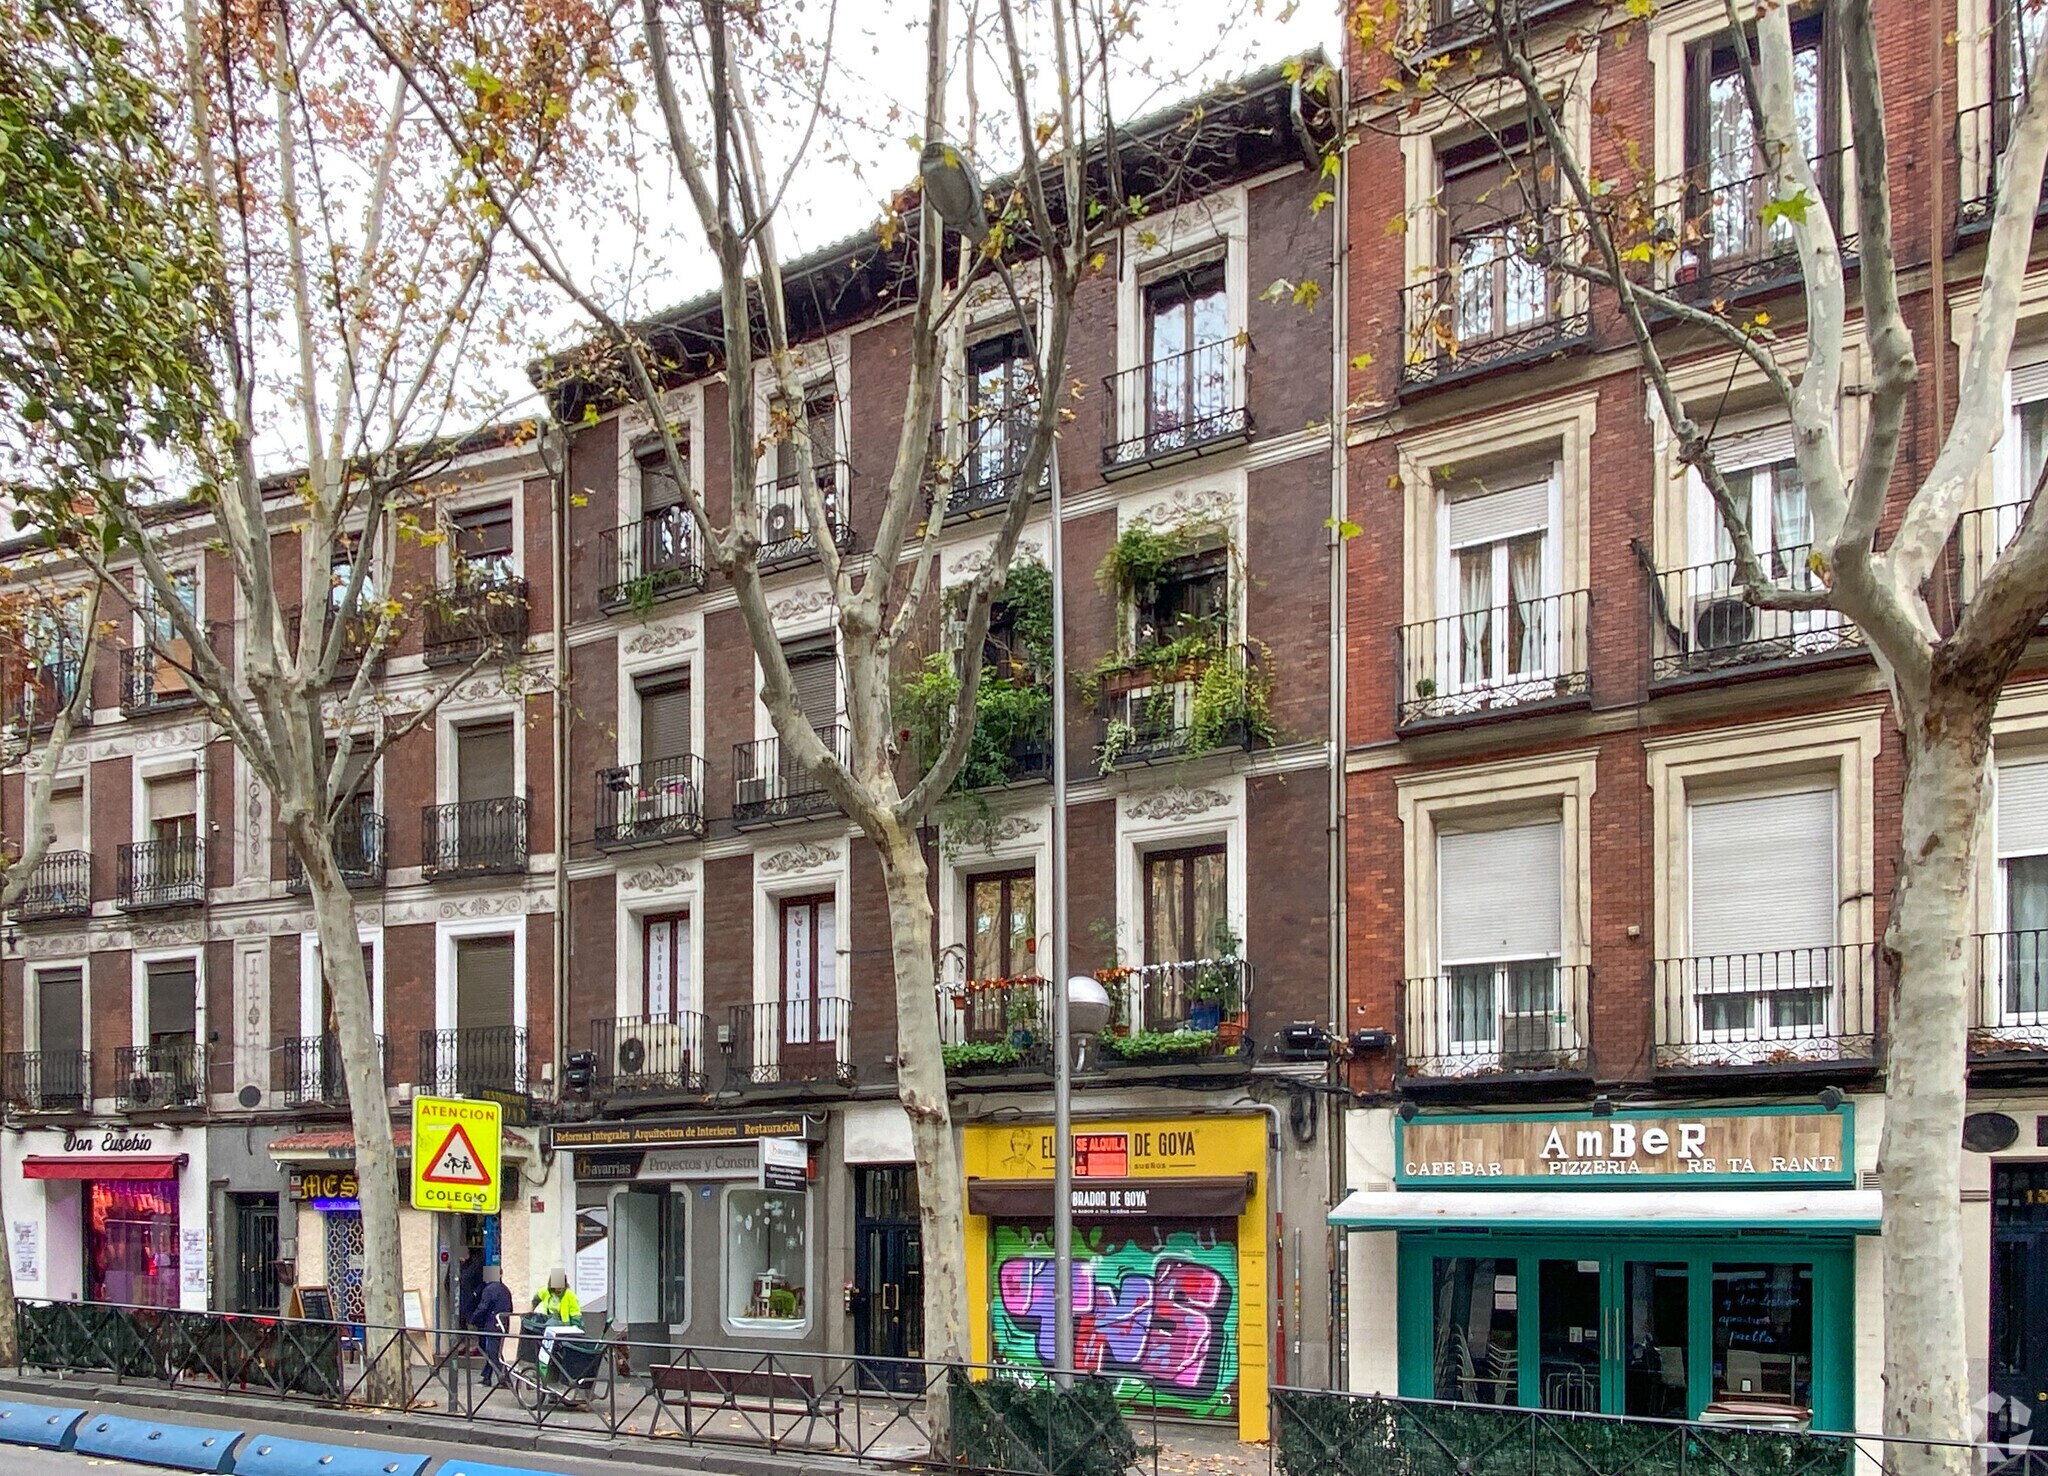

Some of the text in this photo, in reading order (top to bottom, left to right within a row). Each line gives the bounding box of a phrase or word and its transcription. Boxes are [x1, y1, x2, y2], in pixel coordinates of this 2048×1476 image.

[422, 1105, 495, 1121] ATENCION
[556, 1129, 630, 1143] Reformas Integrales
[634, 1126, 737, 1141] Arquitectura de Interiores
[744, 1121, 800, 1135] Restauración
[64, 1132, 152, 1152] Don Eusebio
[1076, 1136, 1126, 1152] SE ALQUILA
[1134, 1133, 1151, 1157] DE
[1159, 1131, 1196, 1156] GOYA
[649, 1157, 701, 1173] Proyectos
[704, 1159, 712, 1172] y
[715, 1155, 758, 1169] Constru
[1405, 1161, 1503, 1176] CAFE BAR
[1548, 1160, 1641, 1175] PIZZERIA
[1771, 1156, 1836, 1172] RANT
[1072, 1191, 1147, 1207] BRADOR DE GOYA
